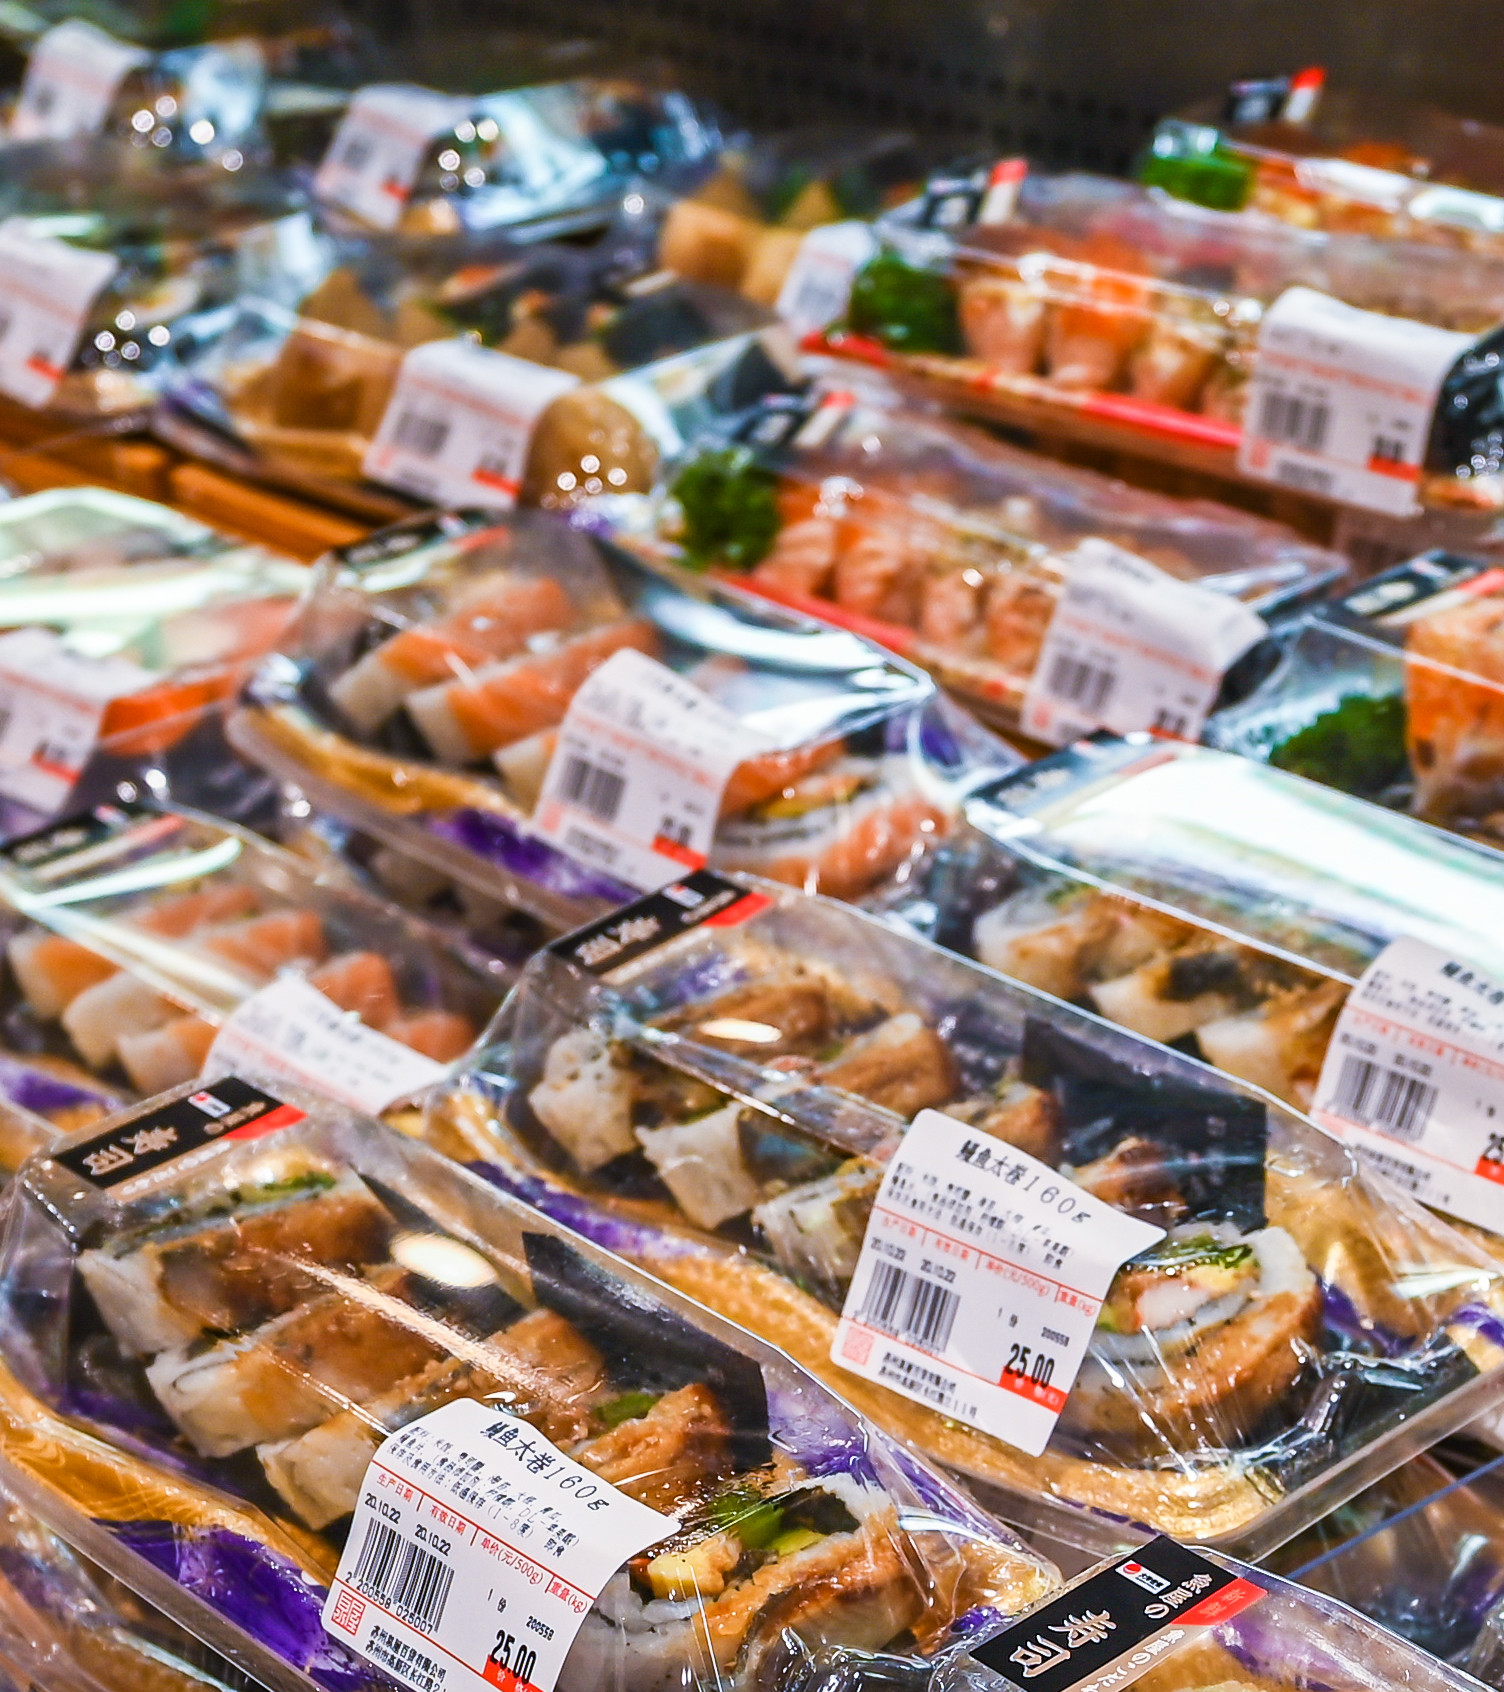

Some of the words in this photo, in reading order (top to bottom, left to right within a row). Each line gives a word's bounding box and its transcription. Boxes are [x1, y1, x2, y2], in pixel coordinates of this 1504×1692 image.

[82, 1125, 179, 1176] 寿司
[1006, 1343, 1055, 1388] 25.00
[365, 1492, 401, 1524] 20.10.22
[415, 1524, 451, 1555] 20.10.22
[376, 1472, 412, 1504] 生产日期
[431, 1504, 466, 1536] 有效日期
[481, 1537, 544, 1586] 单价(元/500g)
[551, 1577, 588, 1614] 重量(kg)
[345, 1572, 352, 1583] 2
[356, 1578, 391, 1609] 200558
[395, 1605, 433, 1634] 025007
[487, 1588, 493, 1601] 1
[496, 1597, 506, 1613] 份
[526, 1615, 555, 1641] 200558
[1144, 1573, 1213, 1619] 魚屋の
[1198, 1588, 1246, 1618] 新鮮
[490, 1629, 537, 1684] 25.00
[1009, 1609, 1117, 1678] 寿司
